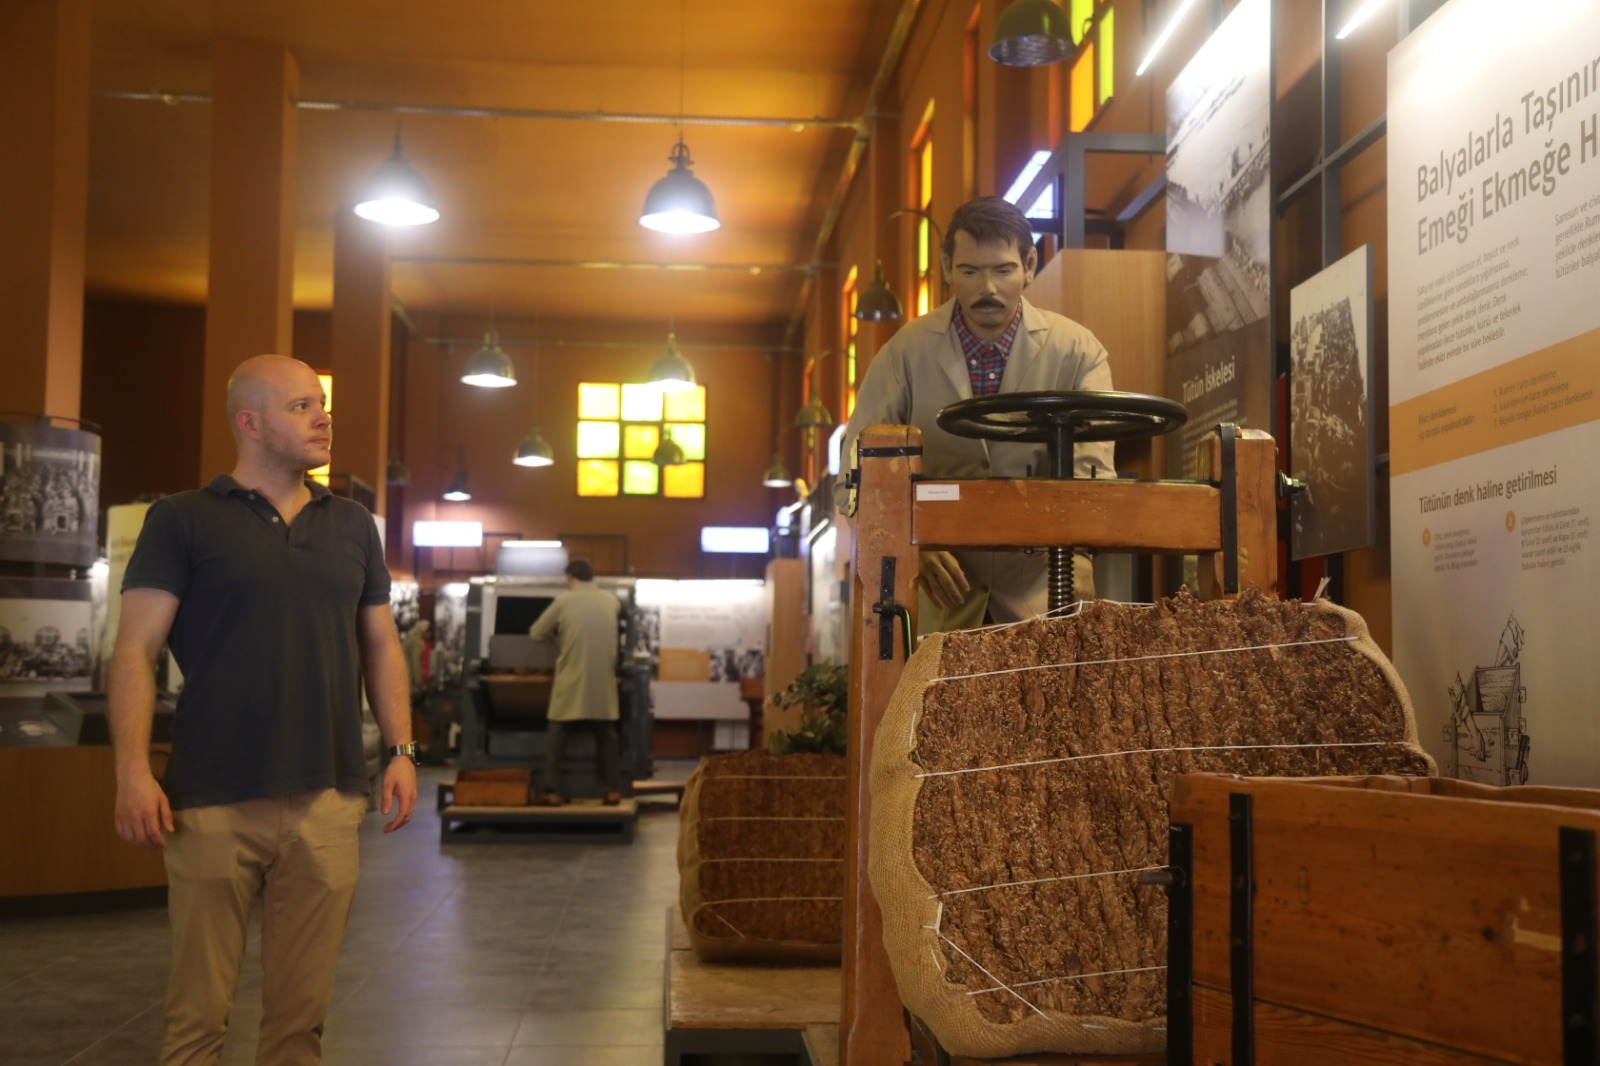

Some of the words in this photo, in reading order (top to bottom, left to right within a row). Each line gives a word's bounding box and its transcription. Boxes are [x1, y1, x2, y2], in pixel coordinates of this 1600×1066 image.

[1418, 111, 1513, 203] Balyalarla
[1418, 188, 1474, 256] Emeği
[1482, 138, 1571, 220] Ekmeğe
[1555, 207, 1578, 226] Samsun
[1580, 203, 1587, 212] ve
[1555, 220, 1583, 247] genellikle
[1586, 214, 1600, 228] Rum
[1555, 243, 1576, 264] şekilde
[1578, 232, 1600, 250] denkle
[1556, 260, 1579, 279] tütünler
[1493, 292, 1506, 307] Denk
[1183, 376, 1204, 404] Tütün
[1205, 355, 1235, 392] İskelesi
[1419, 492, 1451, 514] Tütünün
[1454, 485, 1474, 506] denk
[1477, 480, 1503, 501] haline
[1506, 464, 1557, 499] getirilmesi
